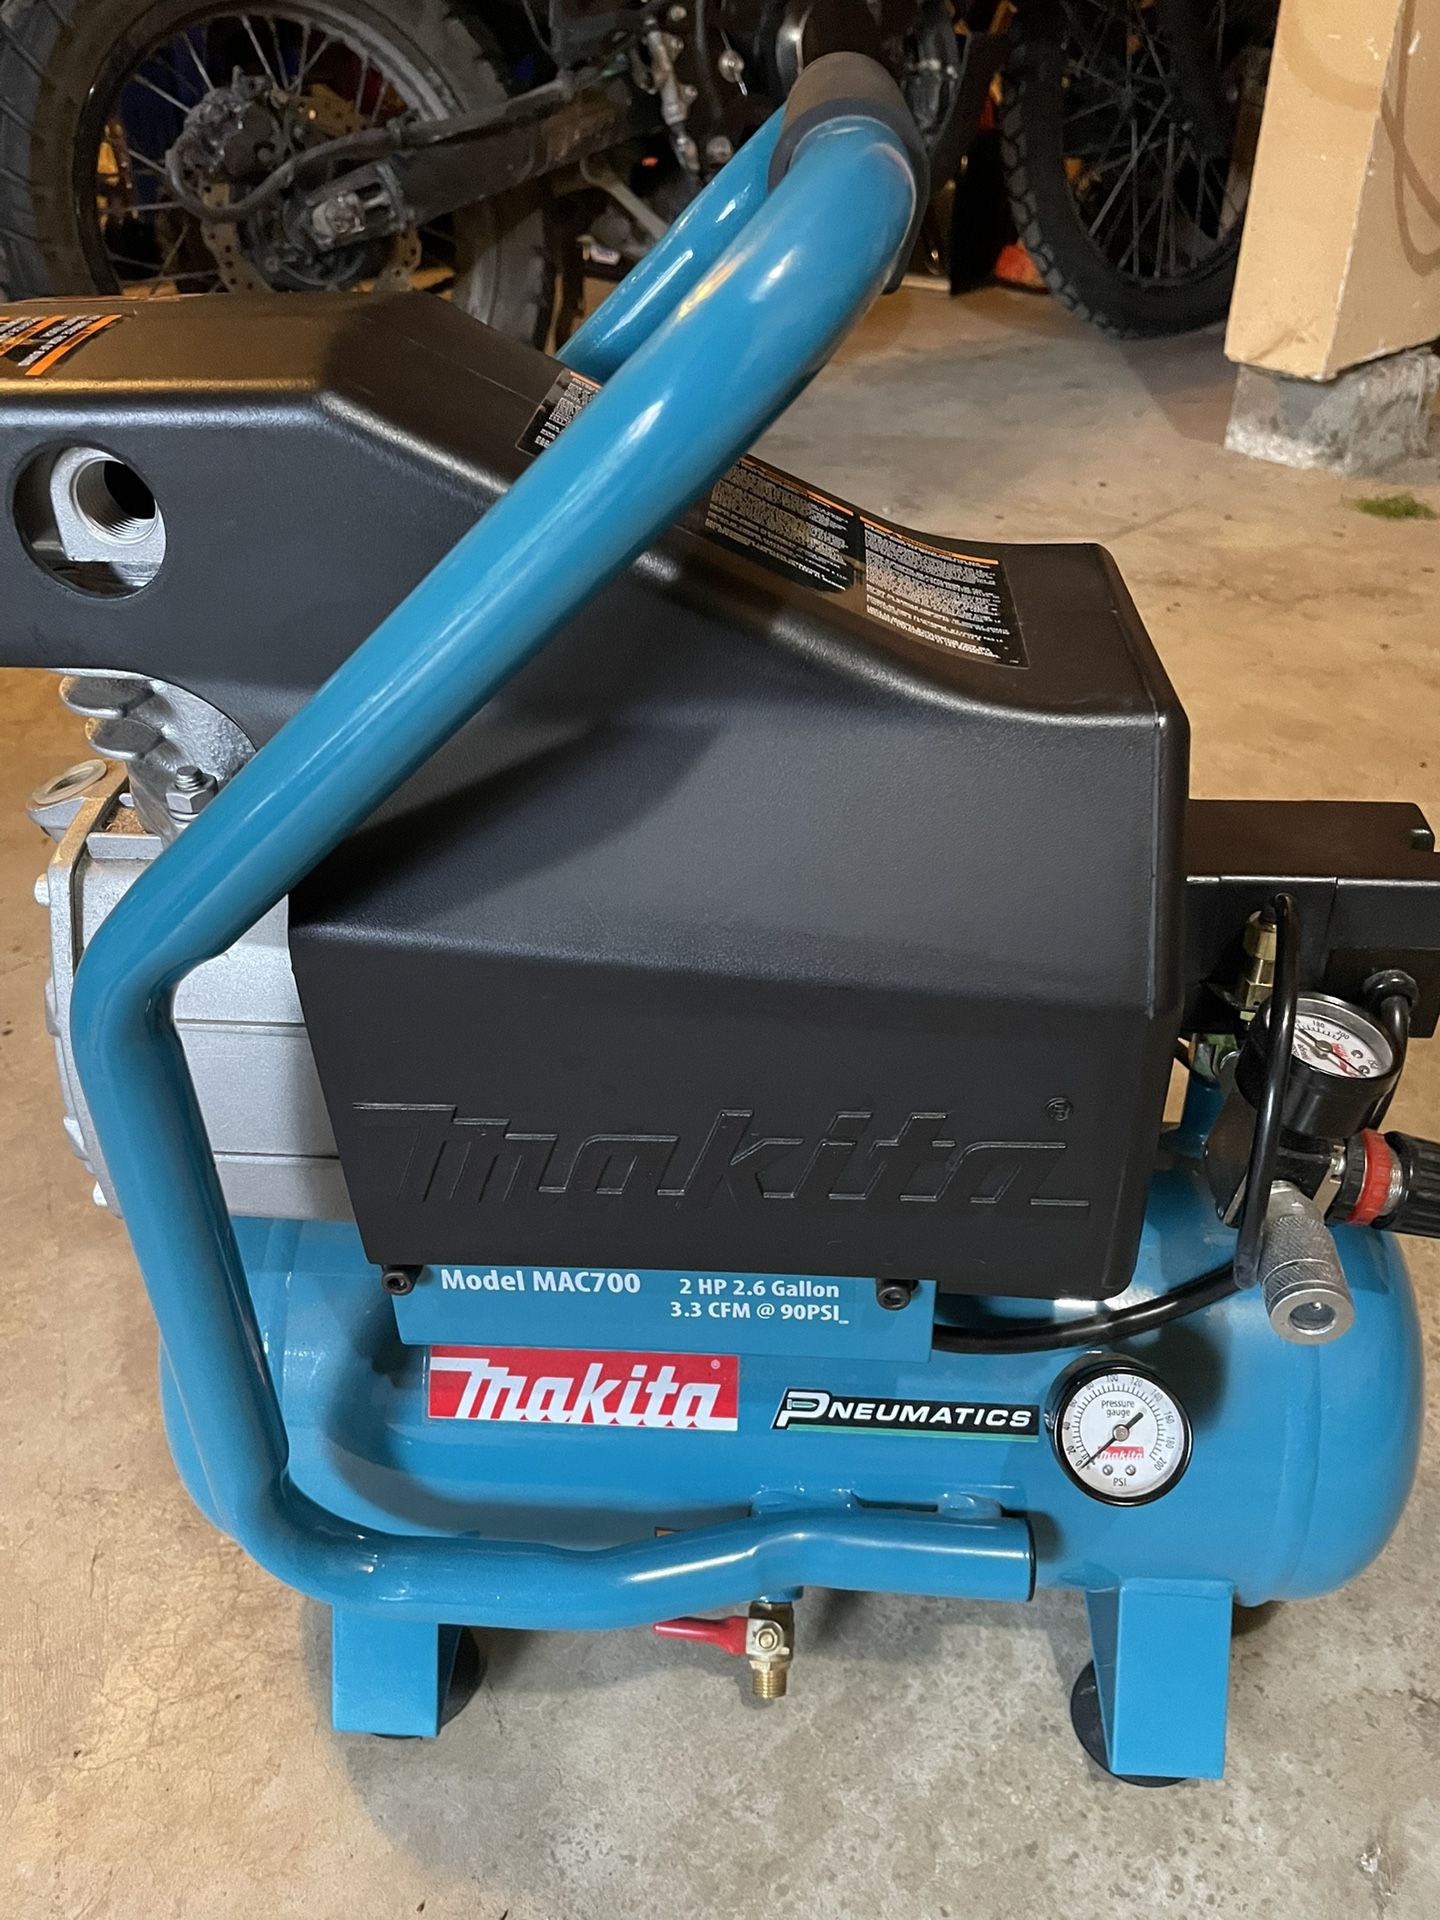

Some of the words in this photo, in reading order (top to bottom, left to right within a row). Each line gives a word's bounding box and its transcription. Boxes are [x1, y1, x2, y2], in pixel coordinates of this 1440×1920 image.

[441, 1270, 525, 1292] Model
[533, 1271, 641, 1294] MAC700
[679, 1279, 692, 1295] 2
[699, 1279, 727, 1296] HP
[733, 1280, 766, 1297] 2.6
[771, 1280, 840, 1299] Gallon
[670, 1302, 702, 1319] 3.3
[708, 1303, 751, 1319] CFM
[756, 1303, 775, 1320] @
[1130, 1376, 1144, 1388] 120
[1150, 1388, 1163, 1402] 140
[776, 1391, 1032, 1428] PNEUMATICS
[1101, 1400, 1135, 1408] pressure
[1106, 1409, 1131, 1418] gauge
[1164, 1411, 1175, 1424] 160
[1166, 1436, 1175, 1449] 180
[1153, 1457, 1168, 1471] 200
[1113, 1477, 1127, 1487] PSI
